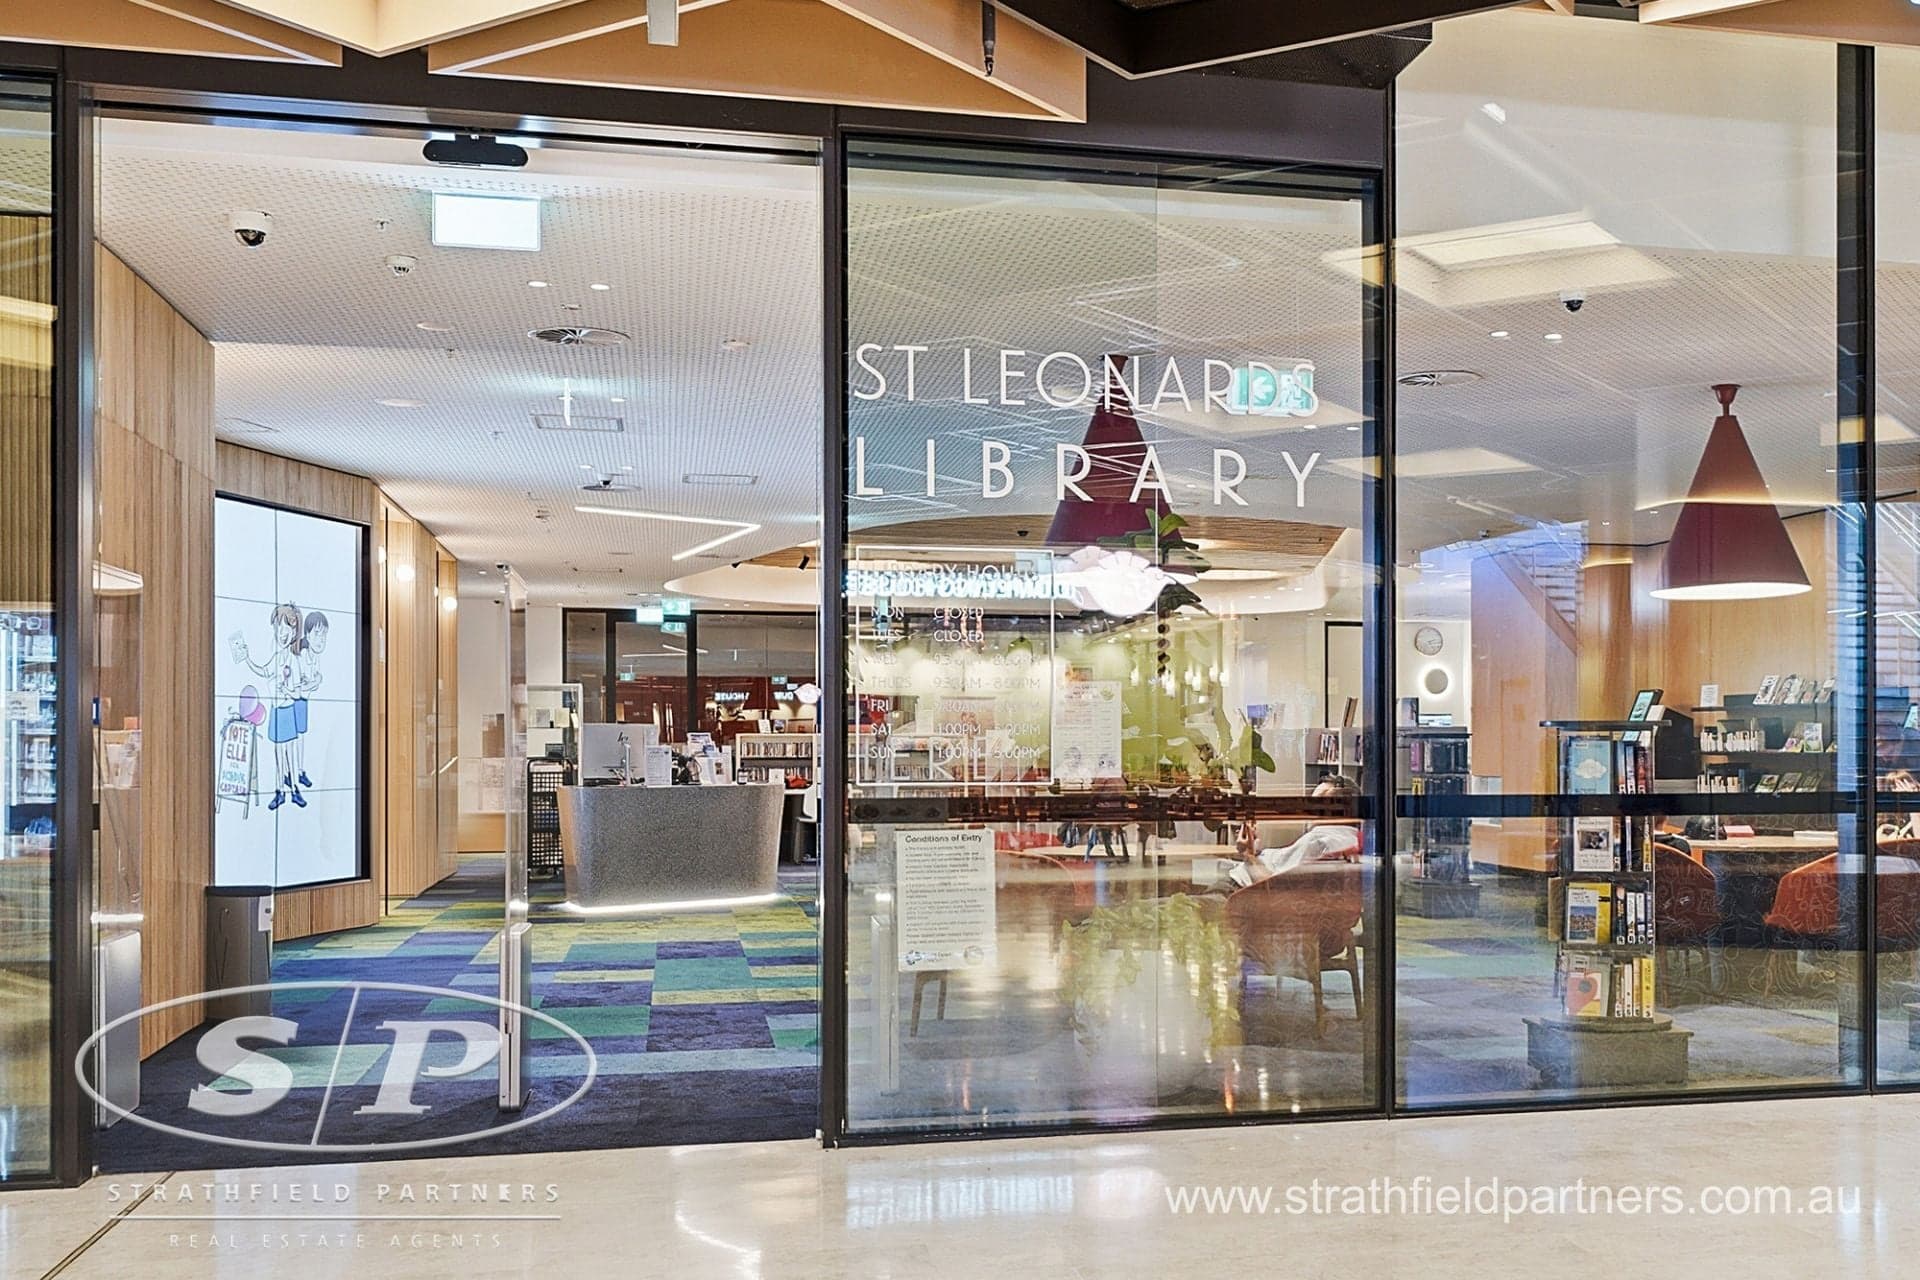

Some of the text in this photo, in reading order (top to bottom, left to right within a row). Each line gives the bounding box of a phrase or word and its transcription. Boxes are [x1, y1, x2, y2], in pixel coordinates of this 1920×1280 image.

[855, 343, 1320, 417] ST LEONARDS
[855, 436, 1321, 508] LIBRARY
[934, 607, 984, 619] CLOSED
[934, 629, 984, 642] CLOSED
[871, 701, 889, 712] FRI
[871, 723, 892, 735] SAT
[871, 747, 896, 759] SUN
[961, 833, 982, 847] Entry
